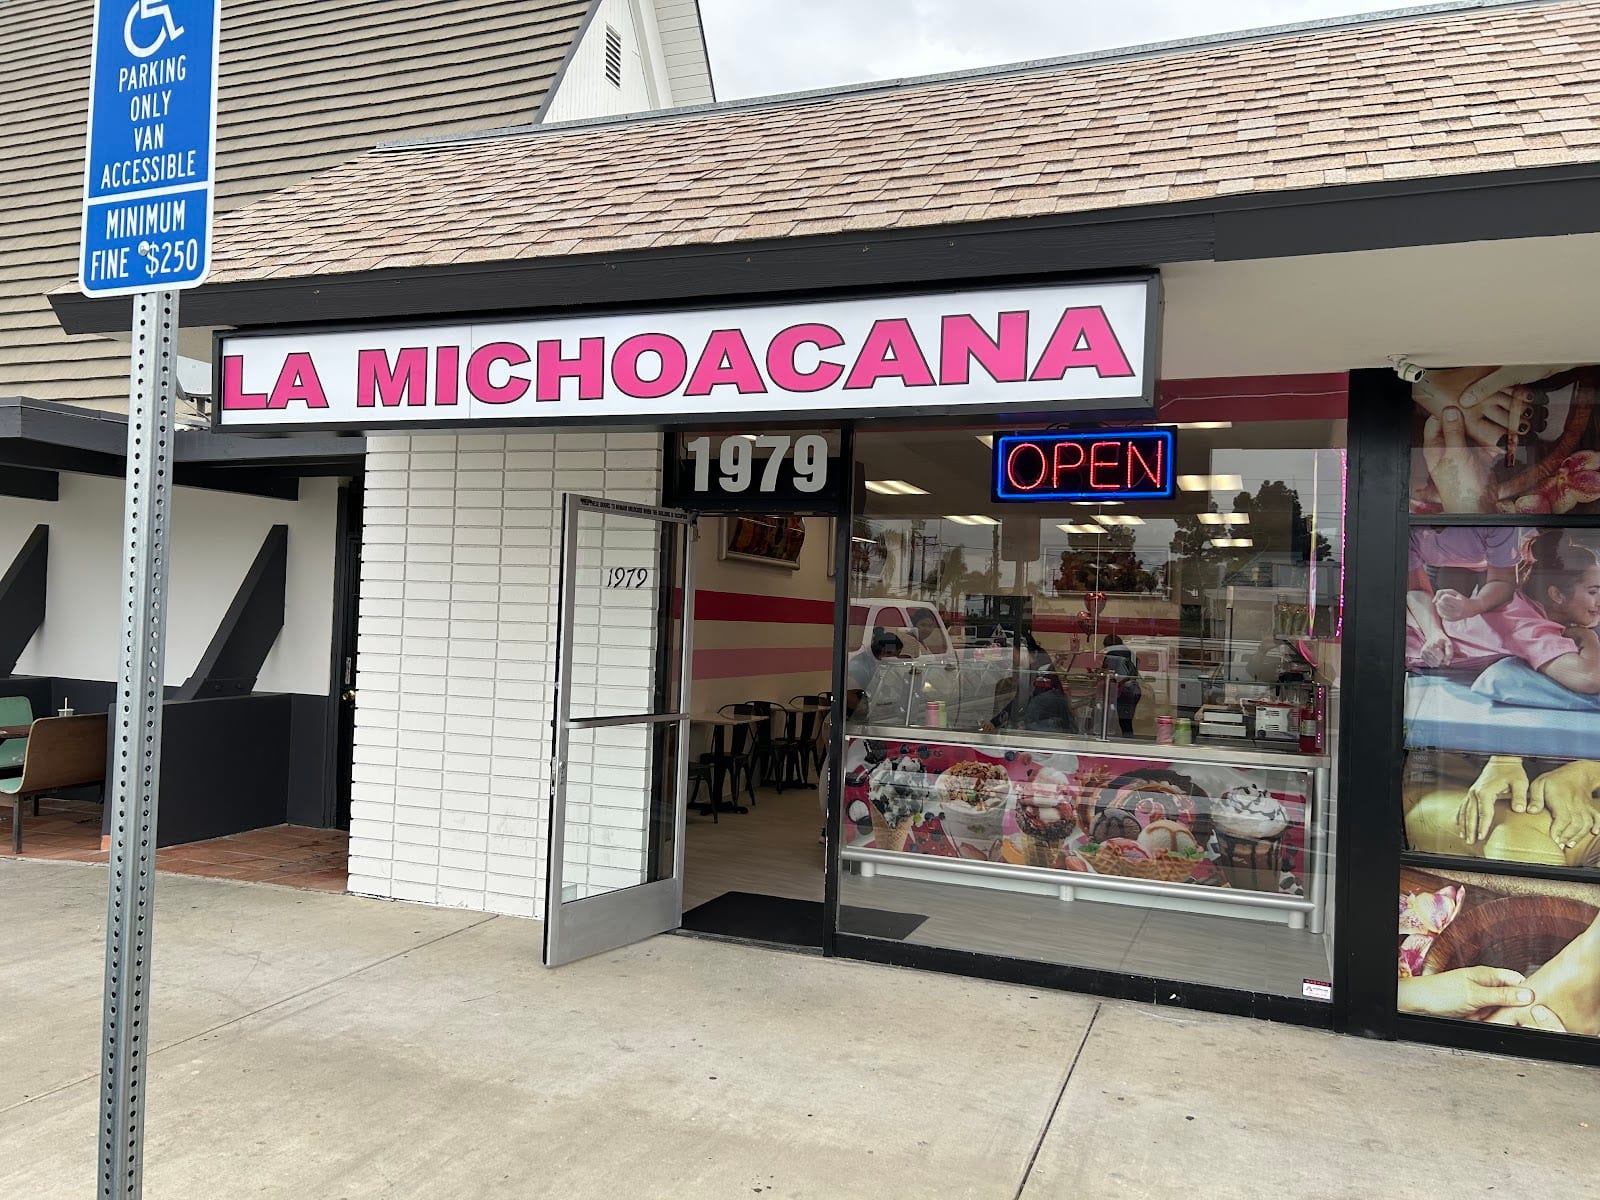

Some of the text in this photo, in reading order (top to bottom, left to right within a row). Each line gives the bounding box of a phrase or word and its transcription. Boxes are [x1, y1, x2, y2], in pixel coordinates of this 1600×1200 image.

[119, 55, 187, 93] PARKING
[130, 90, 172, 122] ONLY
[134, 123, 164, 153] VAN
[100, 150, 196, 190] ACCESSIBLE
[106, 200, 186, 240] MINIMUM
[90, 238, 198, 281] FINE $250
[223, 305, 1135, 410] LA MICHOACANA
[688, 434, 828, 493] 1979
[1007, 440, 1162, 490] OPEN
[607, 567, 648, 588] 1979
